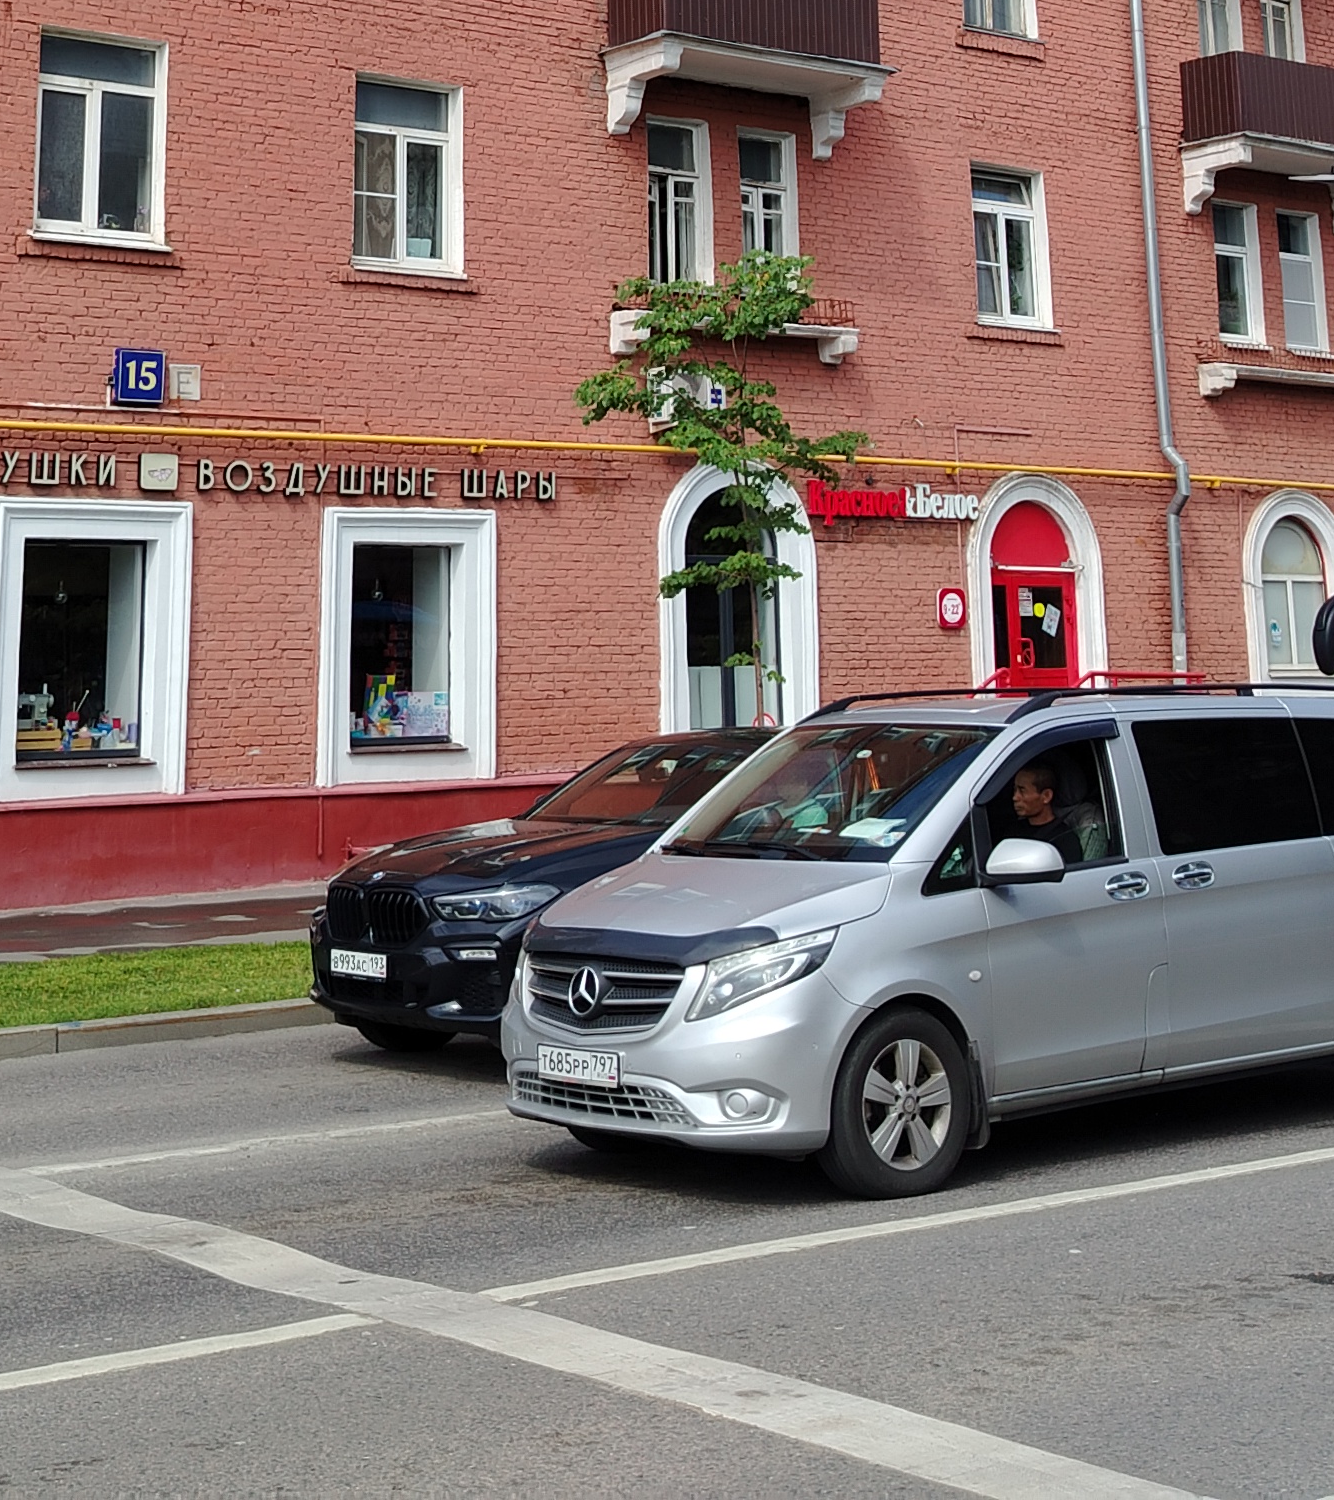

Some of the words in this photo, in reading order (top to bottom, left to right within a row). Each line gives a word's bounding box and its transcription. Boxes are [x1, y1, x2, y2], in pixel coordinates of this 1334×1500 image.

[126, 360, 157, 391] 15
[197, 458, 439, 498] ВОЗДУШНЫЕ
[460, 468, 557, 500] ШАРЫ
